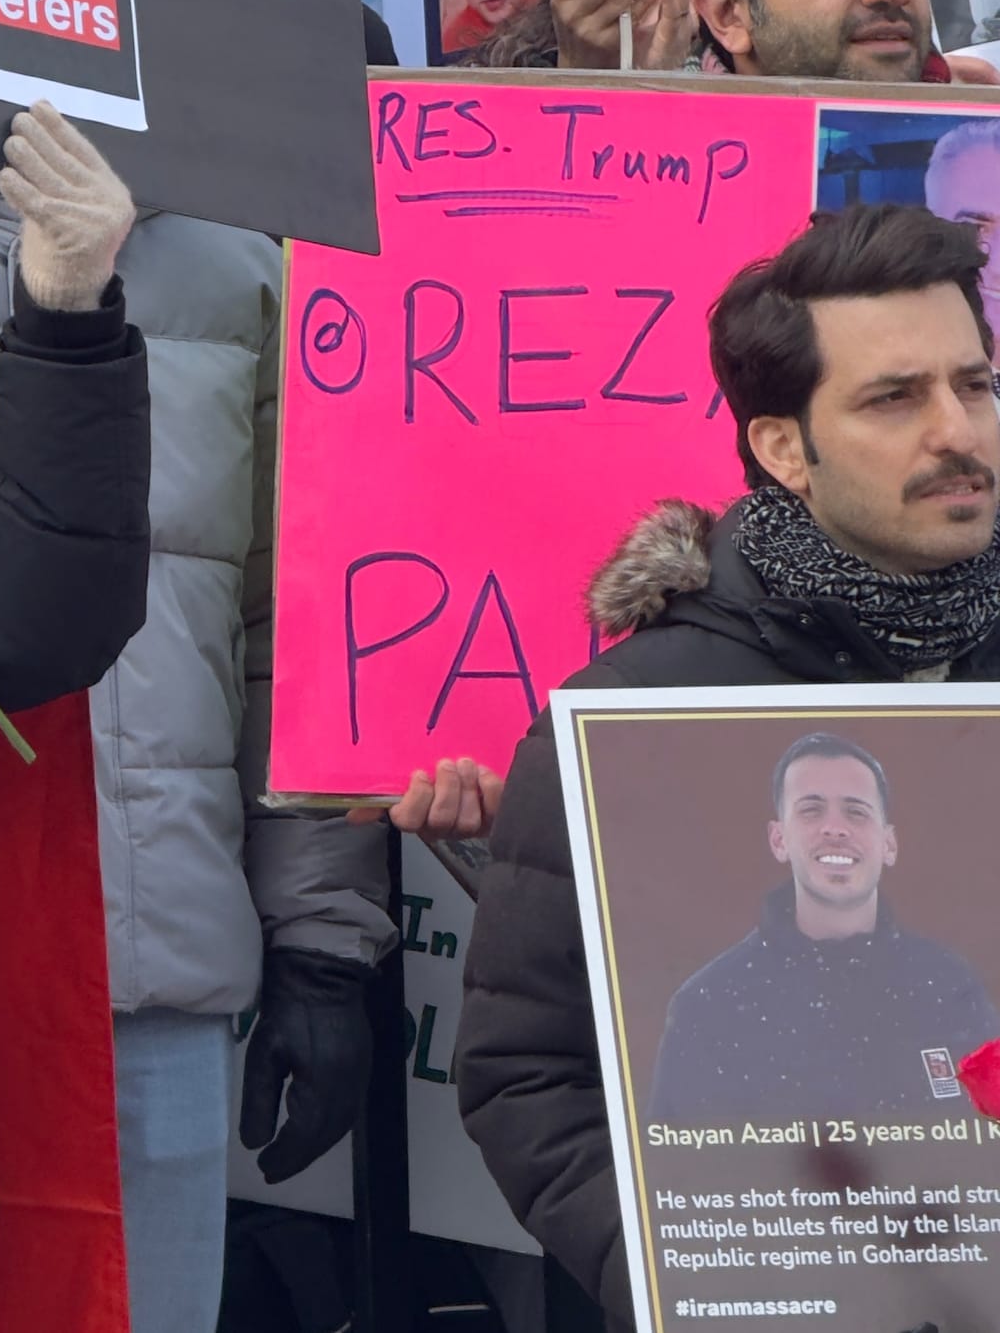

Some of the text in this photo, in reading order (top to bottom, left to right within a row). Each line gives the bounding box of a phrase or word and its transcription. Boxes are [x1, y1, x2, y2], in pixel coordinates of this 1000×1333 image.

[540, 104, 749, 225] Trump
[648, 1123, 734, 1150] Shayan
[741, 1121, 806, 1145] Azadi
[826, 1121, 857, 1142] 25
[862, 1124, 926, 1146] years
[931, 1119, 968, 1140] old
[656, 1190, 687, 1209] He
[692, 1193, 735, 1209] was
[740, 1188, 787, 1208] shot
[791, 1187, 841, 1207] from
[846, 1185, 917, 1206] behind
[922, 1184, 961, 1204] and
[660, 1218, 748, 1242] multiple
[752, 1217, 825, 1237] bullets
[830, 1215, 879, 1235] fired
[884, 1214, 909, 1238] by
[913, 1213, 949, 1234] the
[663, 1243, 989, 1272] Republic regime in Gohardasht.
[675, 1298, 837, 1317] #iranmassacre
